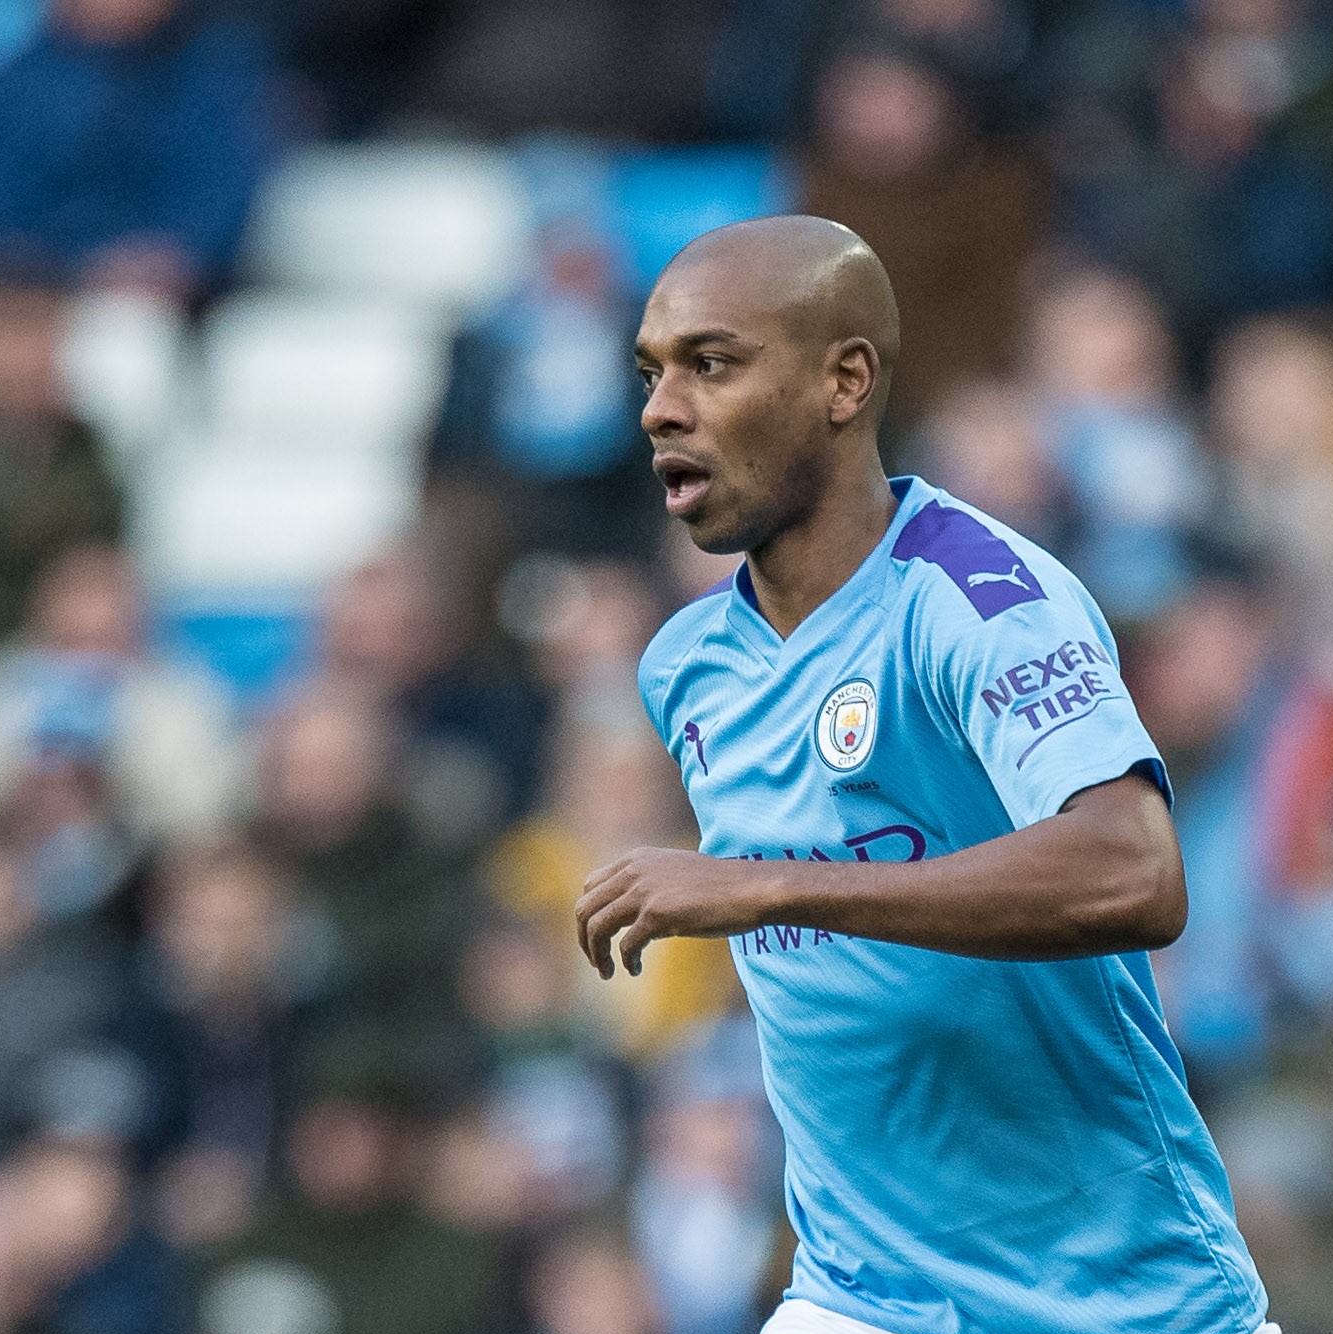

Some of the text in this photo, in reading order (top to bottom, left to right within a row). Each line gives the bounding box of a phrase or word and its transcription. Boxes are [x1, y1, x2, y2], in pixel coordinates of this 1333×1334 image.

[980, 640, 1112, 719] NEXEN
[1014, 670, 1111, 731] TIRE
[838, 755, 857, 766] CITY
[841, 780, 880, 793] YEARS
